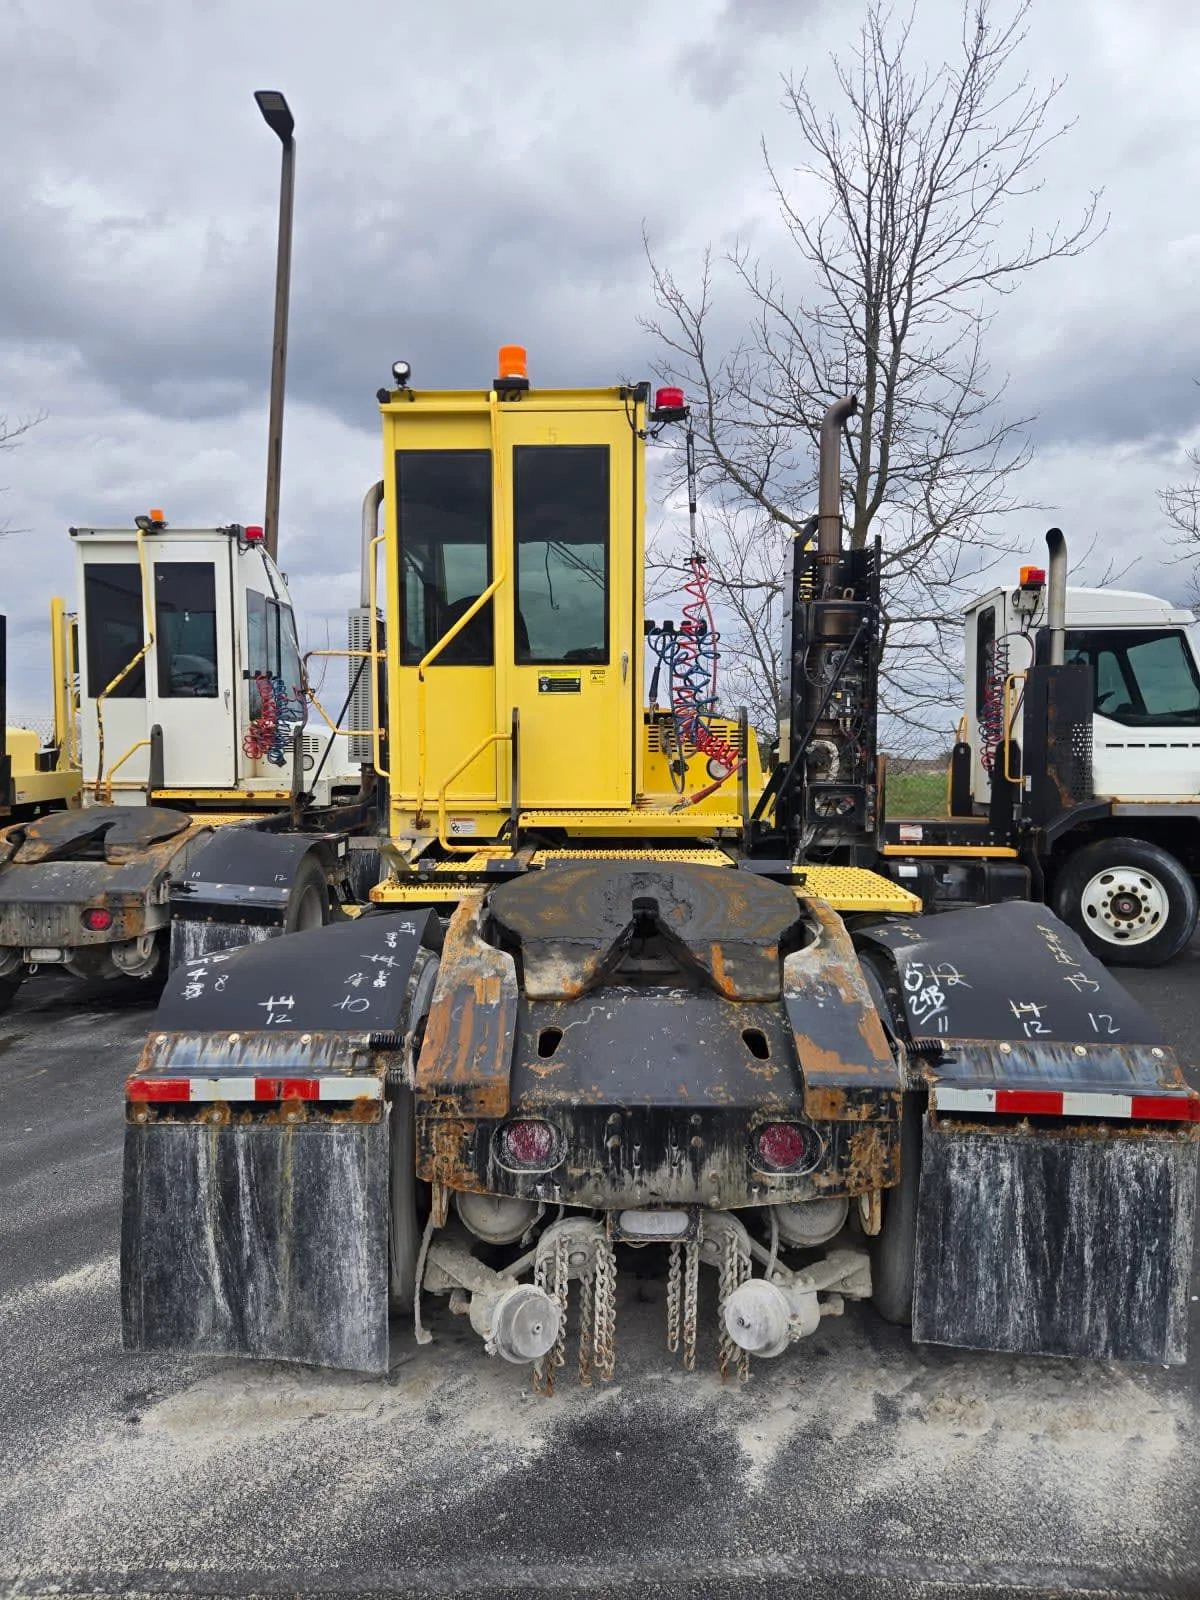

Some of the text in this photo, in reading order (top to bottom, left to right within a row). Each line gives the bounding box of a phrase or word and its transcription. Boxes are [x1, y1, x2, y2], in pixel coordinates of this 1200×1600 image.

[266, 1012, 292, 1025] 12
[938, 1015, 948, 1033] 11
[1087, 1012, 1120, 1034] 12
[1023, 1021, 1052, 1038] 12
